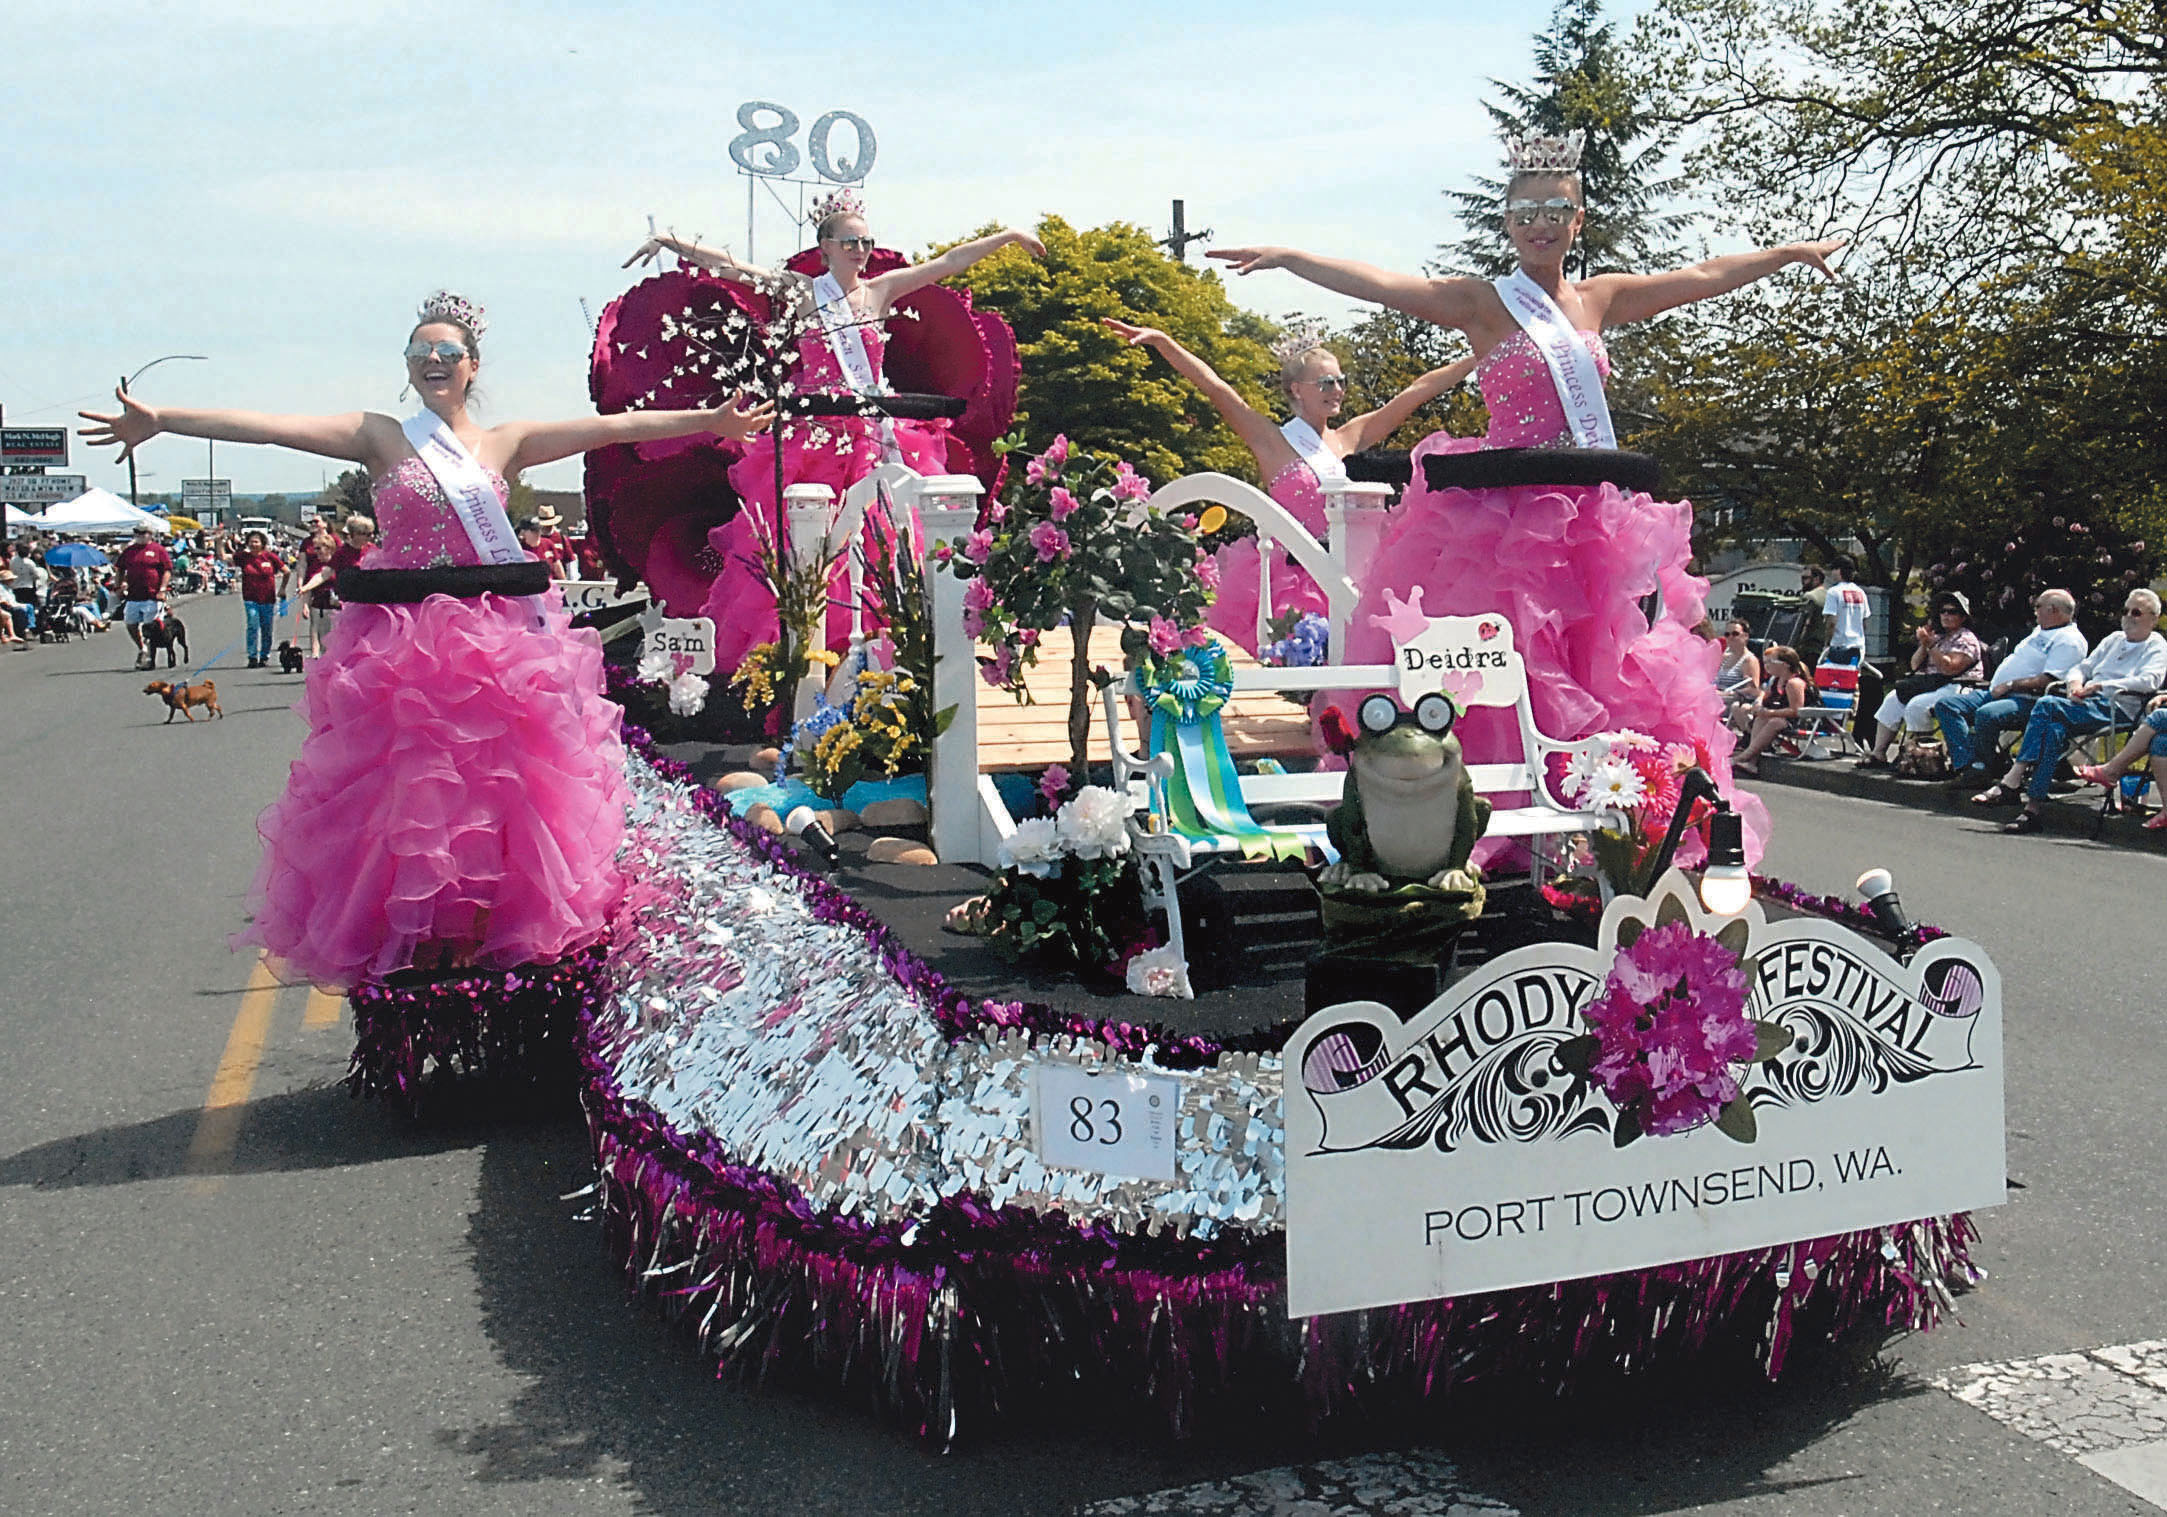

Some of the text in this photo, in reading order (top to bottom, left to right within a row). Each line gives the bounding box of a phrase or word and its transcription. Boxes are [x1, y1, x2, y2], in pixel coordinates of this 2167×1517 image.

[728, 101, 877, 183] 80
[1551, 340, 1605, 449] Princess Dei
[459, 485, 513, 563] Princess Li
[650, 632, 705, 652] Sam
[1403, 647, 1507, 671] Deidra
[1381, 944, 1935, 1120] RHODY FESTIVAL
[1070, 1096, 1122, 1145] 83
[1424, 1146, 1904, 1246] PORT TOWNSEND, WA.
